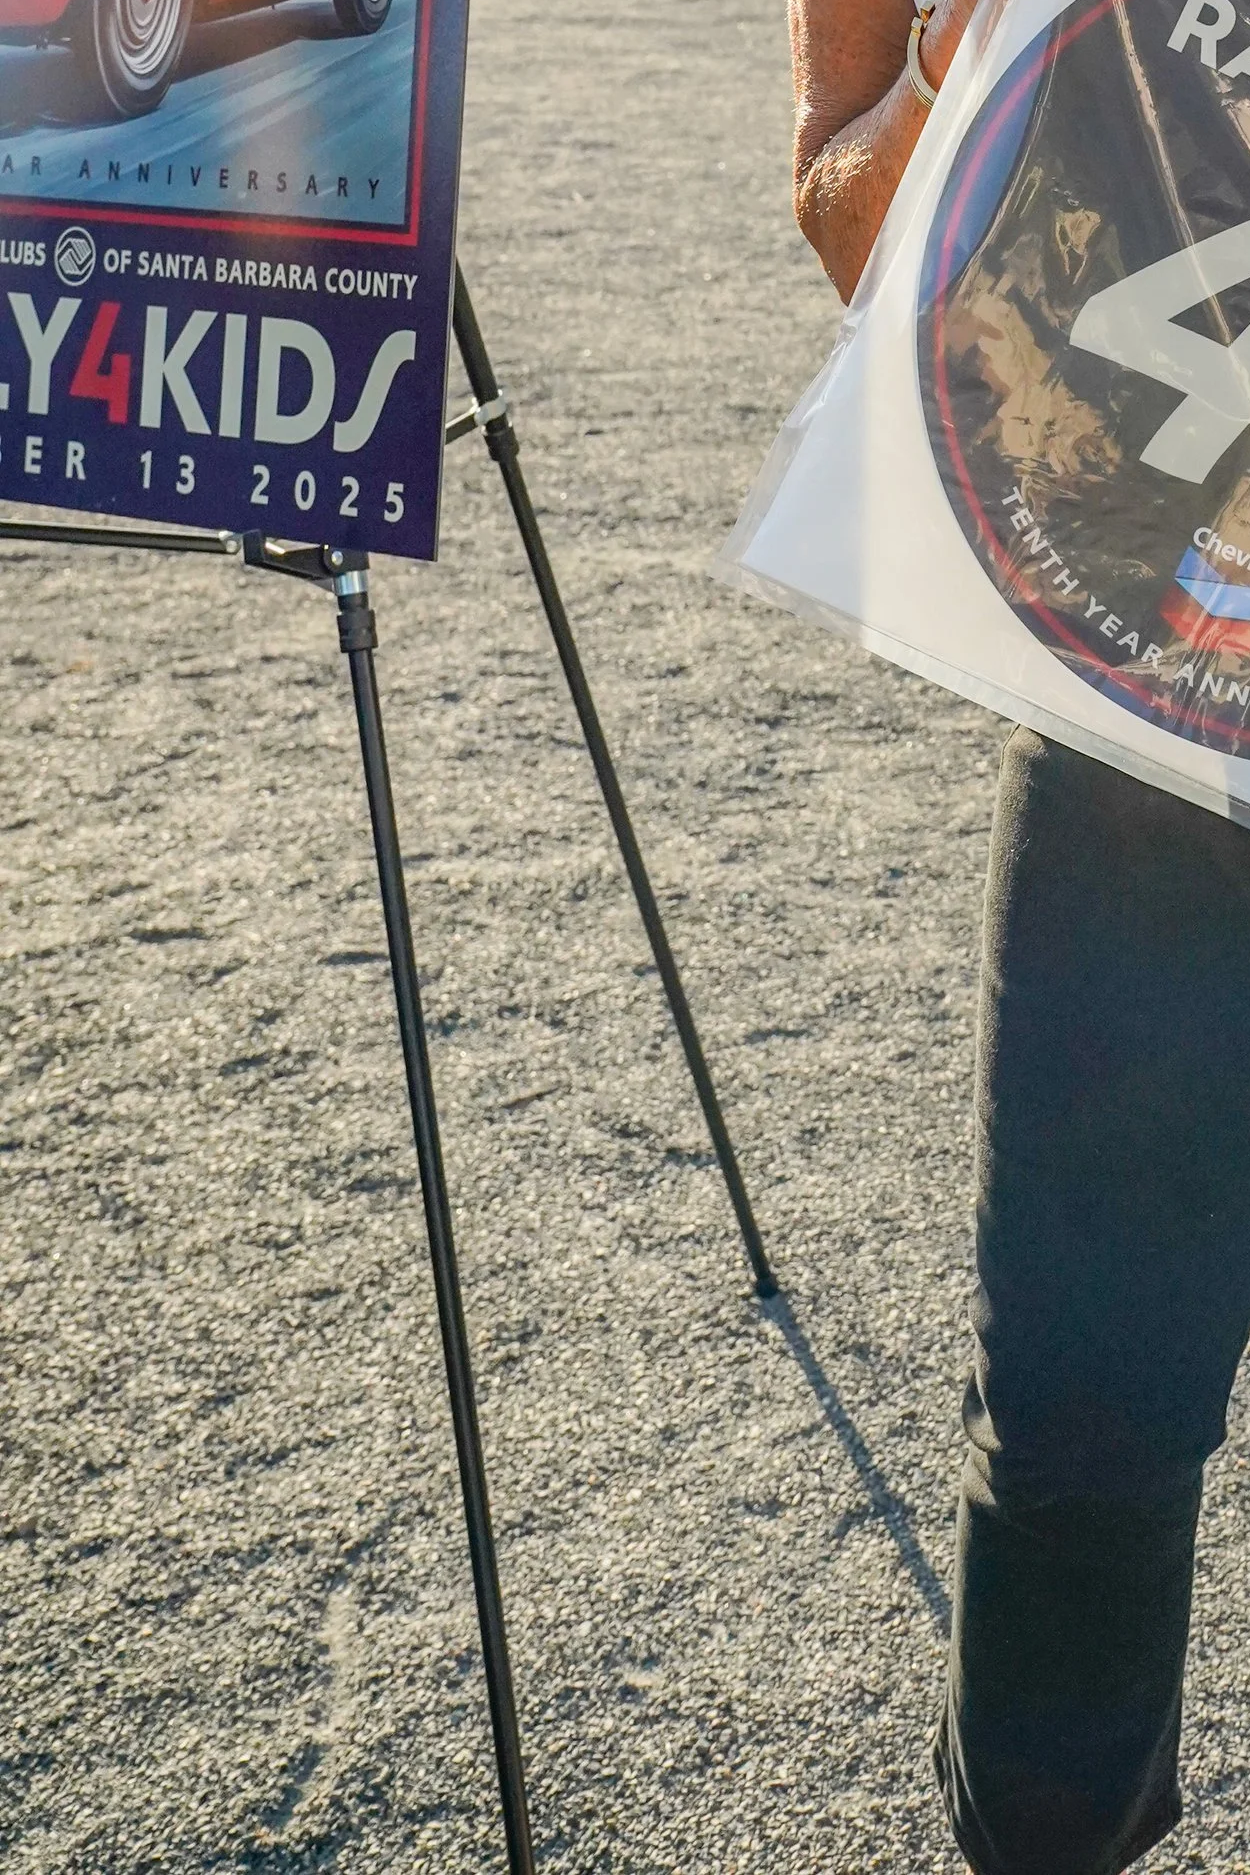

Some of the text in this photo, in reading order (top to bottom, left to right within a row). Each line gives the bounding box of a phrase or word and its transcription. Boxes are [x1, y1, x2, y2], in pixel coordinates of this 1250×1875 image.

[2, 154, 380, 199] AR ANNIVERSARY
[0, 239, 418, 300] LUBS OF SANTA BARBARA COUNTY
[0, 291, 416, 453] Y4KIDS
[140, 450, 195, 495] 13
[250, 465, 405, 523] 2025
[1000, 486, 1080, 597] TENTH
[1086, 593, 1164, 669] YEAR
